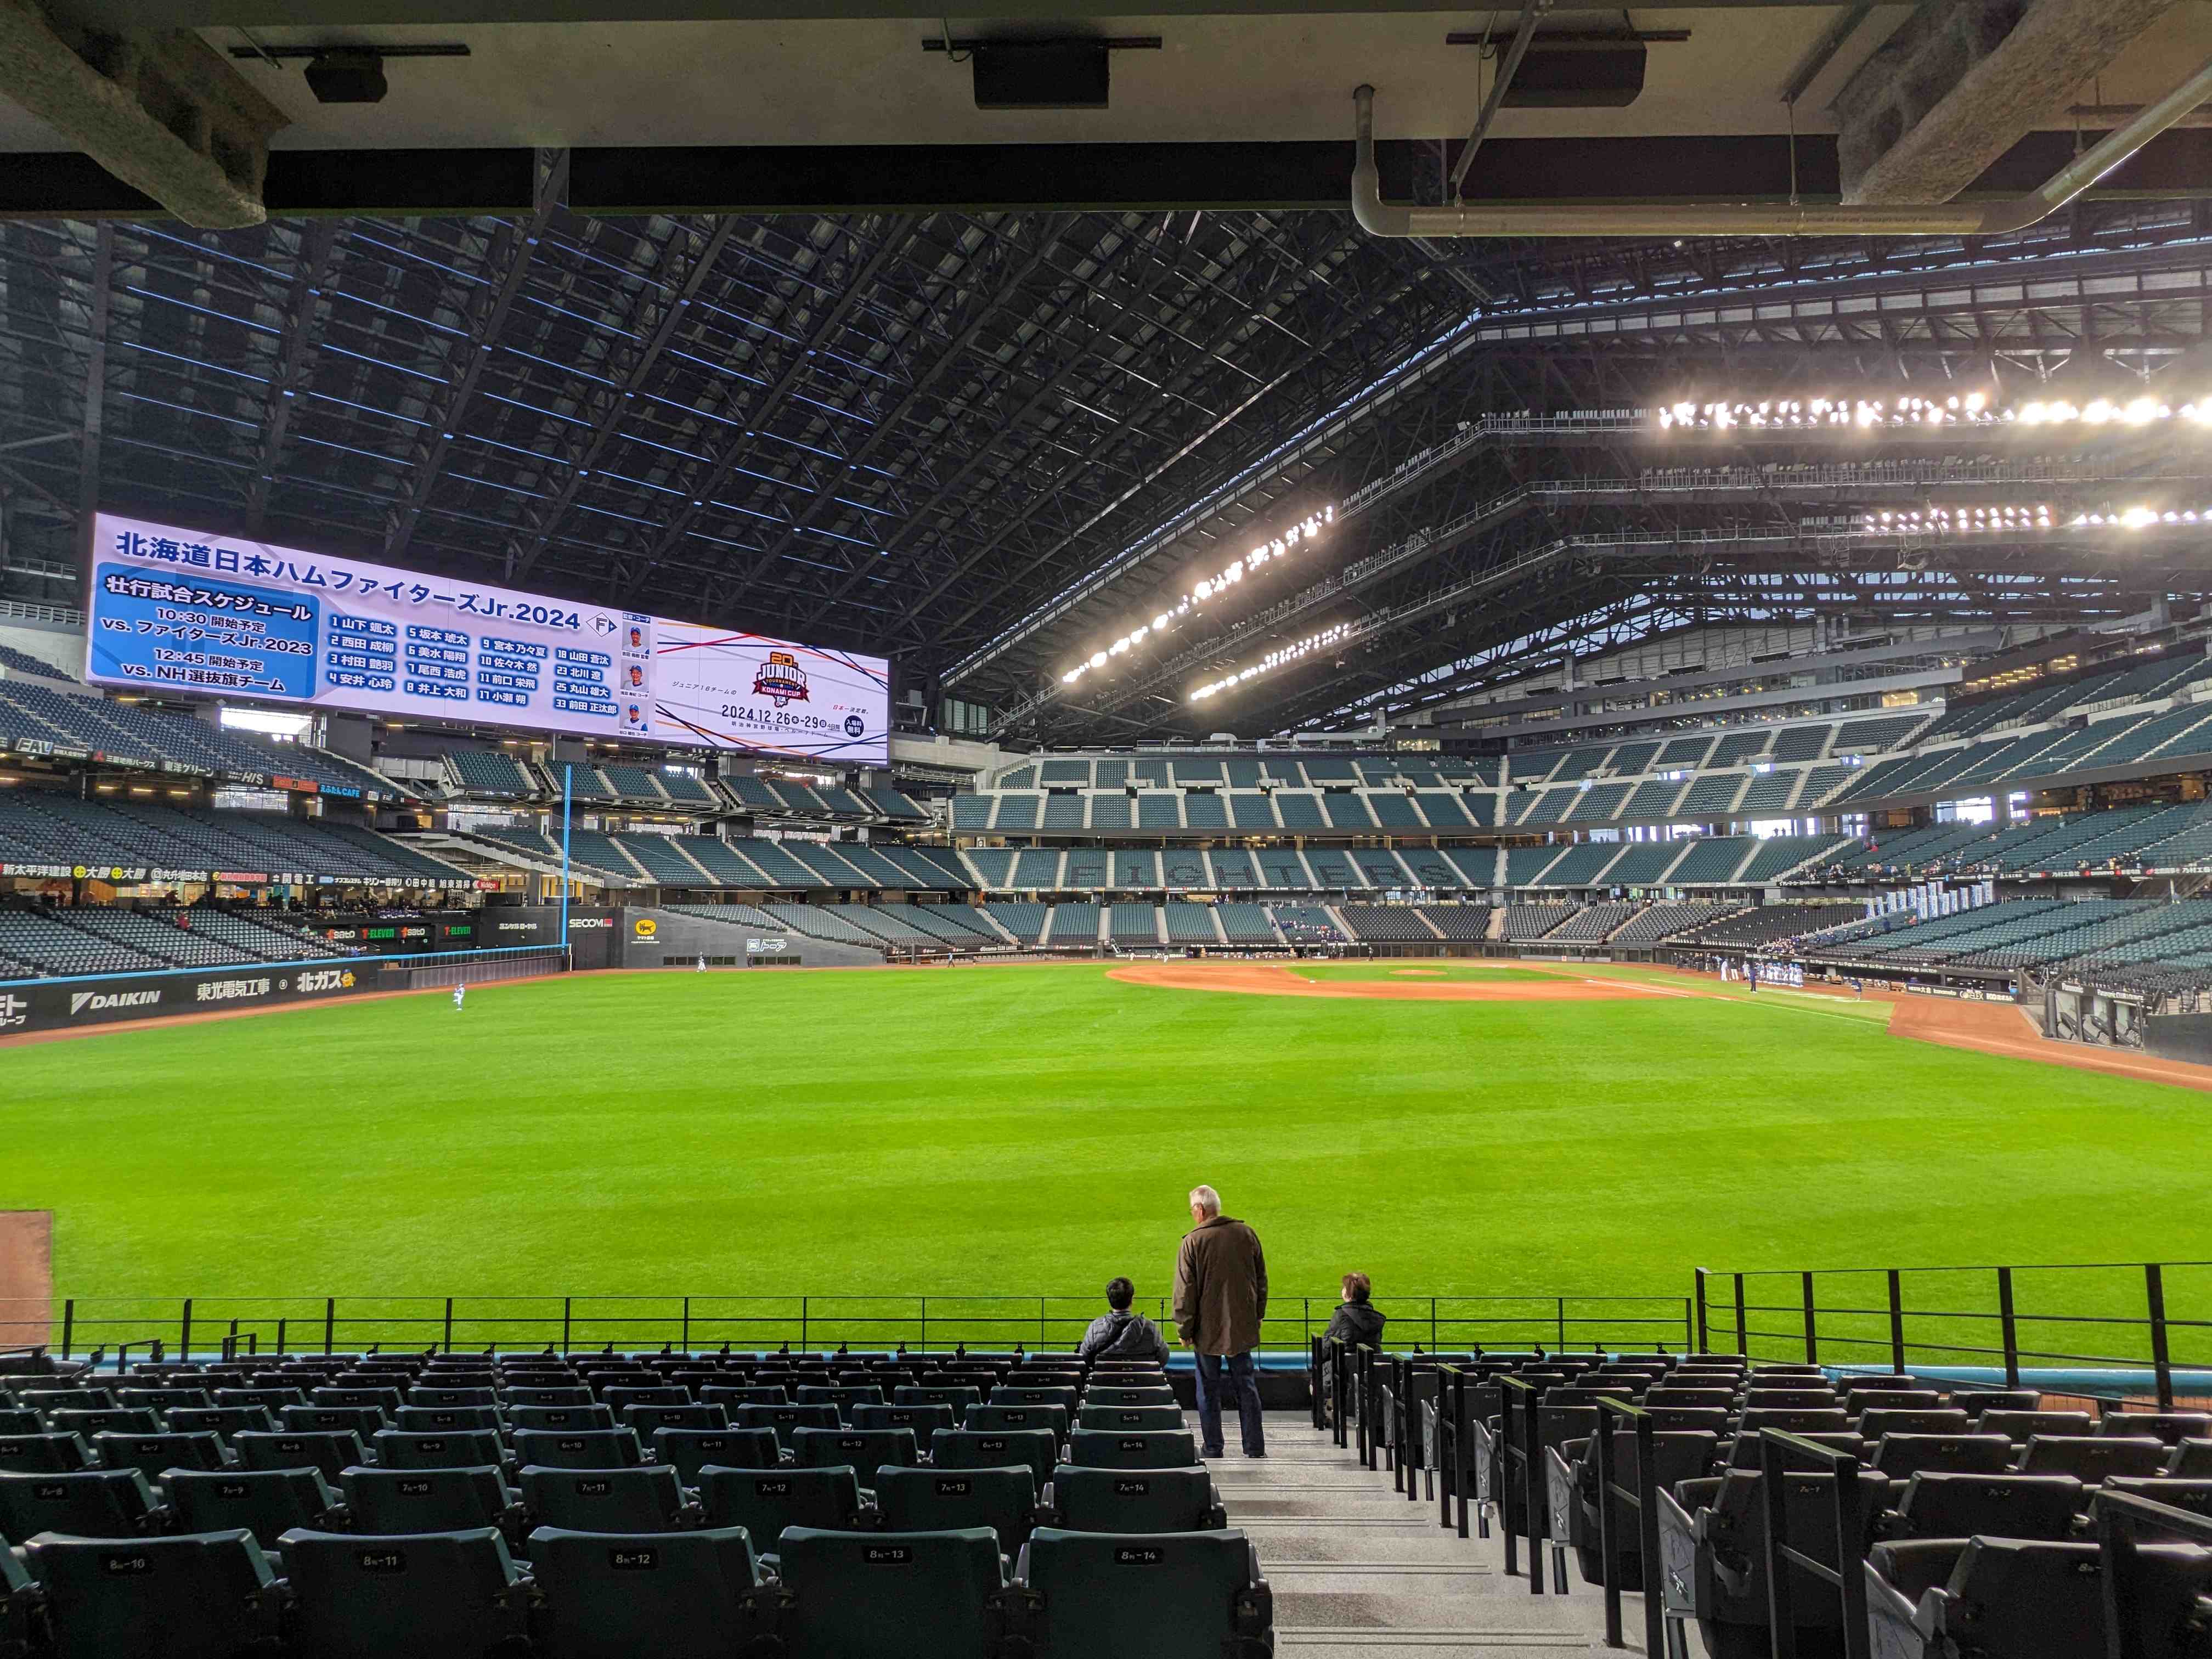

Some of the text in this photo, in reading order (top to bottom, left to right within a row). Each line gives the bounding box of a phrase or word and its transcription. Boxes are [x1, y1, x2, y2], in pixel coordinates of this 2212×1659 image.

[106, 576, 312, 621] 壮行試合スケジュール
[156, 608, 265, 634] 10:30 開始予定
[332, 617, 337, 626] 1
[342, 618, 367, 631] 山下
[101, 619, 313, 655] vs. ファイターズJr.2023
[410, 628, 416, 637] 5
[419, 629, 442, 641] 坂本
[331, 636, 338, 645] 2
[342, 636, 366, 650] 西田
[483, 640, 489, 648] 9
[494, 641, 515, 651] 宮本
[408, 646, 415, 654] 6
[419, 646, 441, 658] 美水
[558, 650, 567, 658] 18
[569, 651, 588, 662] 山田
[155, 648, 263, 672] 12:45 開始予定
[331, 654, 337, 663] 3
[341, 655, 366, 668] 村田
[481, 656, 492, 665] 10
[494, 657, 524, 670] 佐々木
[771, 652, 794, 666] 20
[408, 664, 415, 673] 7
[418, 665, 441, 676] 尾西
[557, 666, 567, 675] 23
[570, 668, 589, 679] 北川
[758, 664, 805, 687] JUNIOR
[123, 664, 285, 692] vs. NH選抜旗チーム
[330, 673, 336, 682] 4
[340, 674, 365, 686] 安井
[480, 674, 489, 682] 11
[492, 674, 512, 686] 前口
[407, 682, 466, 698] 8 井上 大和
[556, 683, 567, 691] 25
[570, 684, 589, 695] 丸山
[762, 686, 787, 695] KONAMI
[479, 691, 489, 699] 17
[493, 692, 514, 703] 小瀬
[556, 699, 566, 708] 33
[569, 700, 588, 711] 前田
[165, 761, 214, 777] 東洋グリーン
[241, 772, 264, 785] HIS
[3, 864, 72, 877] 新太平洋建設
[85, 866, 111, 879] 大勝
[122, 867, 146, 879] 大勝
[413, 878, 435, 887] 田中組
[569, 918, 604, 928] SECOM
[297, 969, 342, 992] 北ガス
[196, 978, 270, 1001] 東光電気工事
[90, 990, 161, 1009] DAIKIN
